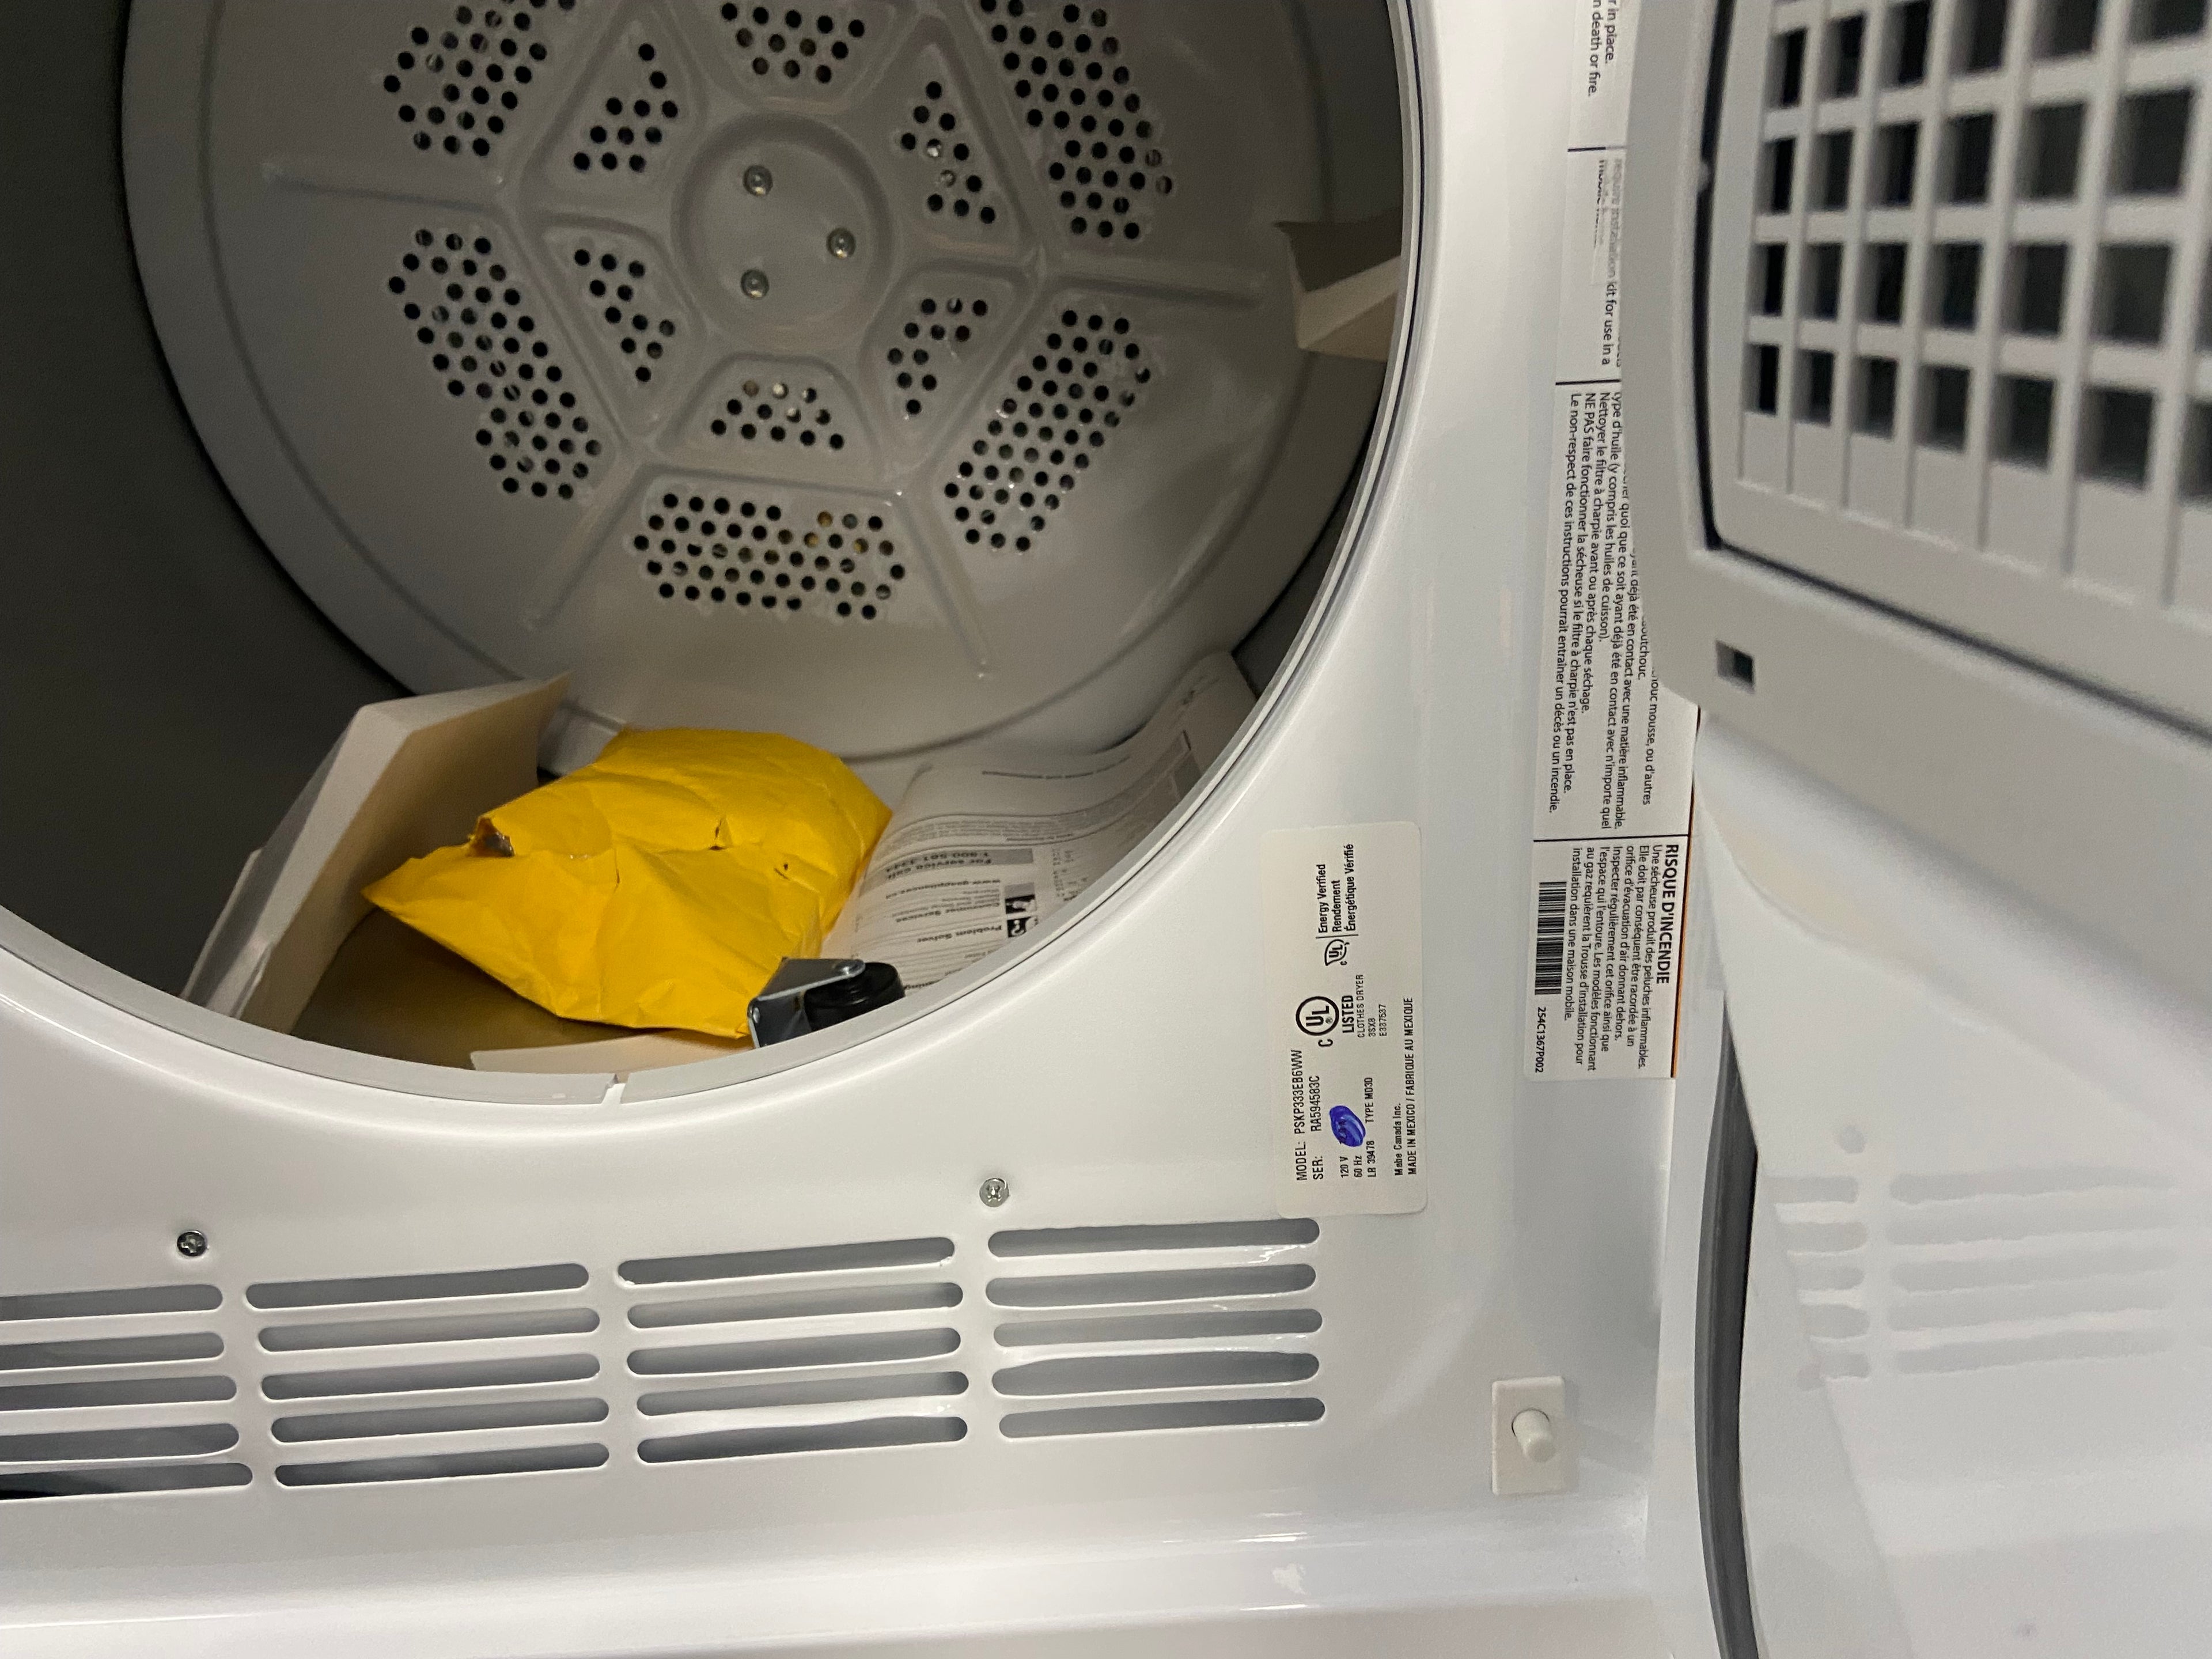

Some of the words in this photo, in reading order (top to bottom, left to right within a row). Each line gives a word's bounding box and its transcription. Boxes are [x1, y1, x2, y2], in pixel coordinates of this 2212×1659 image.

[1607, 8, 1619, 21] in
[1590, 12, 1604, 51] death
[1604, 25, 1617, 64] place.
[1589, 54, 1599, 69] or
[1588, 71, 1601, 96] fire.
[1605, 282, 1617, 297] kit
[1605, 299, 1617, 317] for
[1603, 320, 1612, 340] use
[1602, 344, 1614, 355] in
[1570, 393, 1582, 407] Le
[1585, 392, 1596, 410] NE
[1611, 392, 1622, 418] type
[1584, 412, 1595, 434] PAS
[1595, 392, 1611, 444] Nettoyer
[1565, 410, 1578, 480] non-respect
[1581, 436, 1594, 462] faire
[1610, 420, 1623, 460] d'huile
[1594, 459, 1607, 486] filtre
[1607, 463, 1620, 474] (y
[1565, 482, 1577, 498] de
[1578, 464, 1593, 532] fonctionner
[1605, 476, 1617, 522] compris
[1564, 499, 1573, 518] ces
[1589, 497, 1604, 540] charpie
[1618, 503, 1630, 528] quoi
[1605, 524, 1617, 540] les
[1617, 531, 1628, 554] que
[1560, 521, 1574, 587] instructions
[1589, 542, 1600, 574] avant
[1603, 543, 1616, 576] huiles
[1617, 555, 1626, 569] ce
[1574, 546, 1588, 597] sécheuse
[1602, 577, 1613, 593] de
[1616, 571, 1627, 592] soit
[1558, 589, 1569, 633] pourrait
[1585, 593, 1598, 623] après
[1597, 594, 1611, 642] cuisson).
[1612, 593, 1624, 624] ayant
[1628, 604, 1639, 622] été
[1571, 623, 1584, 648] filtre
[1582, 625, 1596, 665] chaque
[1610, 626, 1624, 649] déjà
[1556, 635, 1567, 684] entraîner
[1611, 652, 1623, 669] été
[1624, 638, 1635, 678] contact
[1566, 659, 1581, 699] charpie
[1579, 668, 1594, 714] séchage.
[1622, 679, 1632, 703] avec
[1553, 703, 1565, 733] décès
[1566, 701, 1579, 726] n'est
[1607, 687, 1618, 727] contact
[1621, 704, 1630, 724] une
[1564, 728, 1575, 746] pas
[1645, 703, 1657, 747] mousse,
[1605, 729, 1615, 753] avec
[1618, 726, 1630, 764] matière
[1549, 767, 1562, 813] incendie.
[1562, 763, 1575, 794] place.
[1601, 755, 1615, 805] n'importe
[1642, 764, 1656, 805] d'autres
[1614, 766, 1628, 830] inflammable.
[1600, 807, 1612, 829] quel
[1343, 844, 1354, 874] Vérifié
[1586, 847, 1595, 859] au
[1596, 846, 1611, 885] l'espace
[1624, 845, 1636, 876] orifice
[1638, 845, 1650, 862] Elle
[1652, 844, 1663, 865] Une
[1316, 863, 1327, 900] Verified
[1570, 847, 1583, 902] installation
[1584, 861, 1594, 880] gaz
[1609, 846, 1623, 892] Inspecter
[1637, 865, 1649, 885] doit
[1662, 844, 1679, 899] RISQUE
[1595, 887, 1607, 903] qui
[1634, 887, 1645, 903] par
[1648, 866, 1661, 910] sécheuse
[1317, 902, 1330, 934] Energy
[1331, 880, 1342, 933] Rendement
[1343, 876, 1358, 931] Énergétique
[1569, 903, 1580, 927] dans
[1582, 881, 1594, 932] requièrent
[1620, 877, 1634, 940] d'évacuation
[1567, 929, 1577, 948] une
[1594, 905, 1607, 950] l'entoure.
[1606, 893, 1620, 961] régulièrement
[1631, 904, 1644, 961] conséquent
[1646, 911, 1657, 945] produit
[1328, 944, 1343, 958] UL
[1619, 941, 1631, 963] d'air
[1645, 947, 1656, 964] des
[1656, 902, 1675, 984] D'INCENDIE
[1566, 949, 1577, 984] maison
[1580, 942, 1592, 980] Trousse
[1593, 952, 1604, 968] Les
[1605, 963, 1615, 979] cet
[1631, 963, 1642, 982] être
[1355, 974, 1365, 1001] DRYER
[1590, 969, 1602, 1010] modèles
[1603, 980, 1615, 1009] orifice
[1616, 964, 1629, 1005] donnant
[1642, 965, 1654, 1006] peluches
[1305, 1005, 1330, 1027] UL
[1341, 995, 1355, 1033] LISTED
[1403, 997, 1414, 1036] MEXIQUE
[1564, 986, 1575, 1021] mobile.
[1577, 981, 1589, 1041] d'installation
[1627, 984, 1639, 1025] racordée
[1356, 1003, 1365, 1038] CLOTHES
[1378, 1004, 1388, 1037] E337537
[1602, 1011, 1612, 1032] ainsi
[1615, 1006, 1626, 1041] dehors.
[1404, 1039, 1414, 1051] AU
[1535, 1006, 1547, 1074] 254C1367P002
[1587, 1012, 1601, 1071] fonctionnant
[1599, 1034, 1609, 1052] que
[1638, 1007, 1652, 1069] inflammables.
[1574, 1043, 1584, 1065] pour
[1363, 1077, 1373, 1100] MD3D
[1404, 1054, 1415, 1096] FABRIQUE
[1290, 1050, 1305, 1134] PSKP333EB6WW
[1308, 1075, 1322, 1132] RA594583C
[1364, 1102, 1374, 1124] TYPE
[1392, 1103, 1402, 1119] Inc.
[1406, 1104, 1416, 1136] MEXICO
[1392, 1120, 1403, 1150] Canada
[1407, 1138, 1416, 1148] IN
[1294, 1141, 1308, 1181] MODEL:
[1353, 1155, 1362, 1166] Hz
[1366, 1140, 1376, 1164] 39478
[1393, 1153, 1403, 1176] Mabe
[1407, 1150, 1417, 1175] MADE
[1312, 1156, 1324, 1180] SER:
[1339, 1164, 1349, 1179] 120
[1353, 1168, 1363, 1178] 60
[1367, 1167, 1377, 1177] LR
